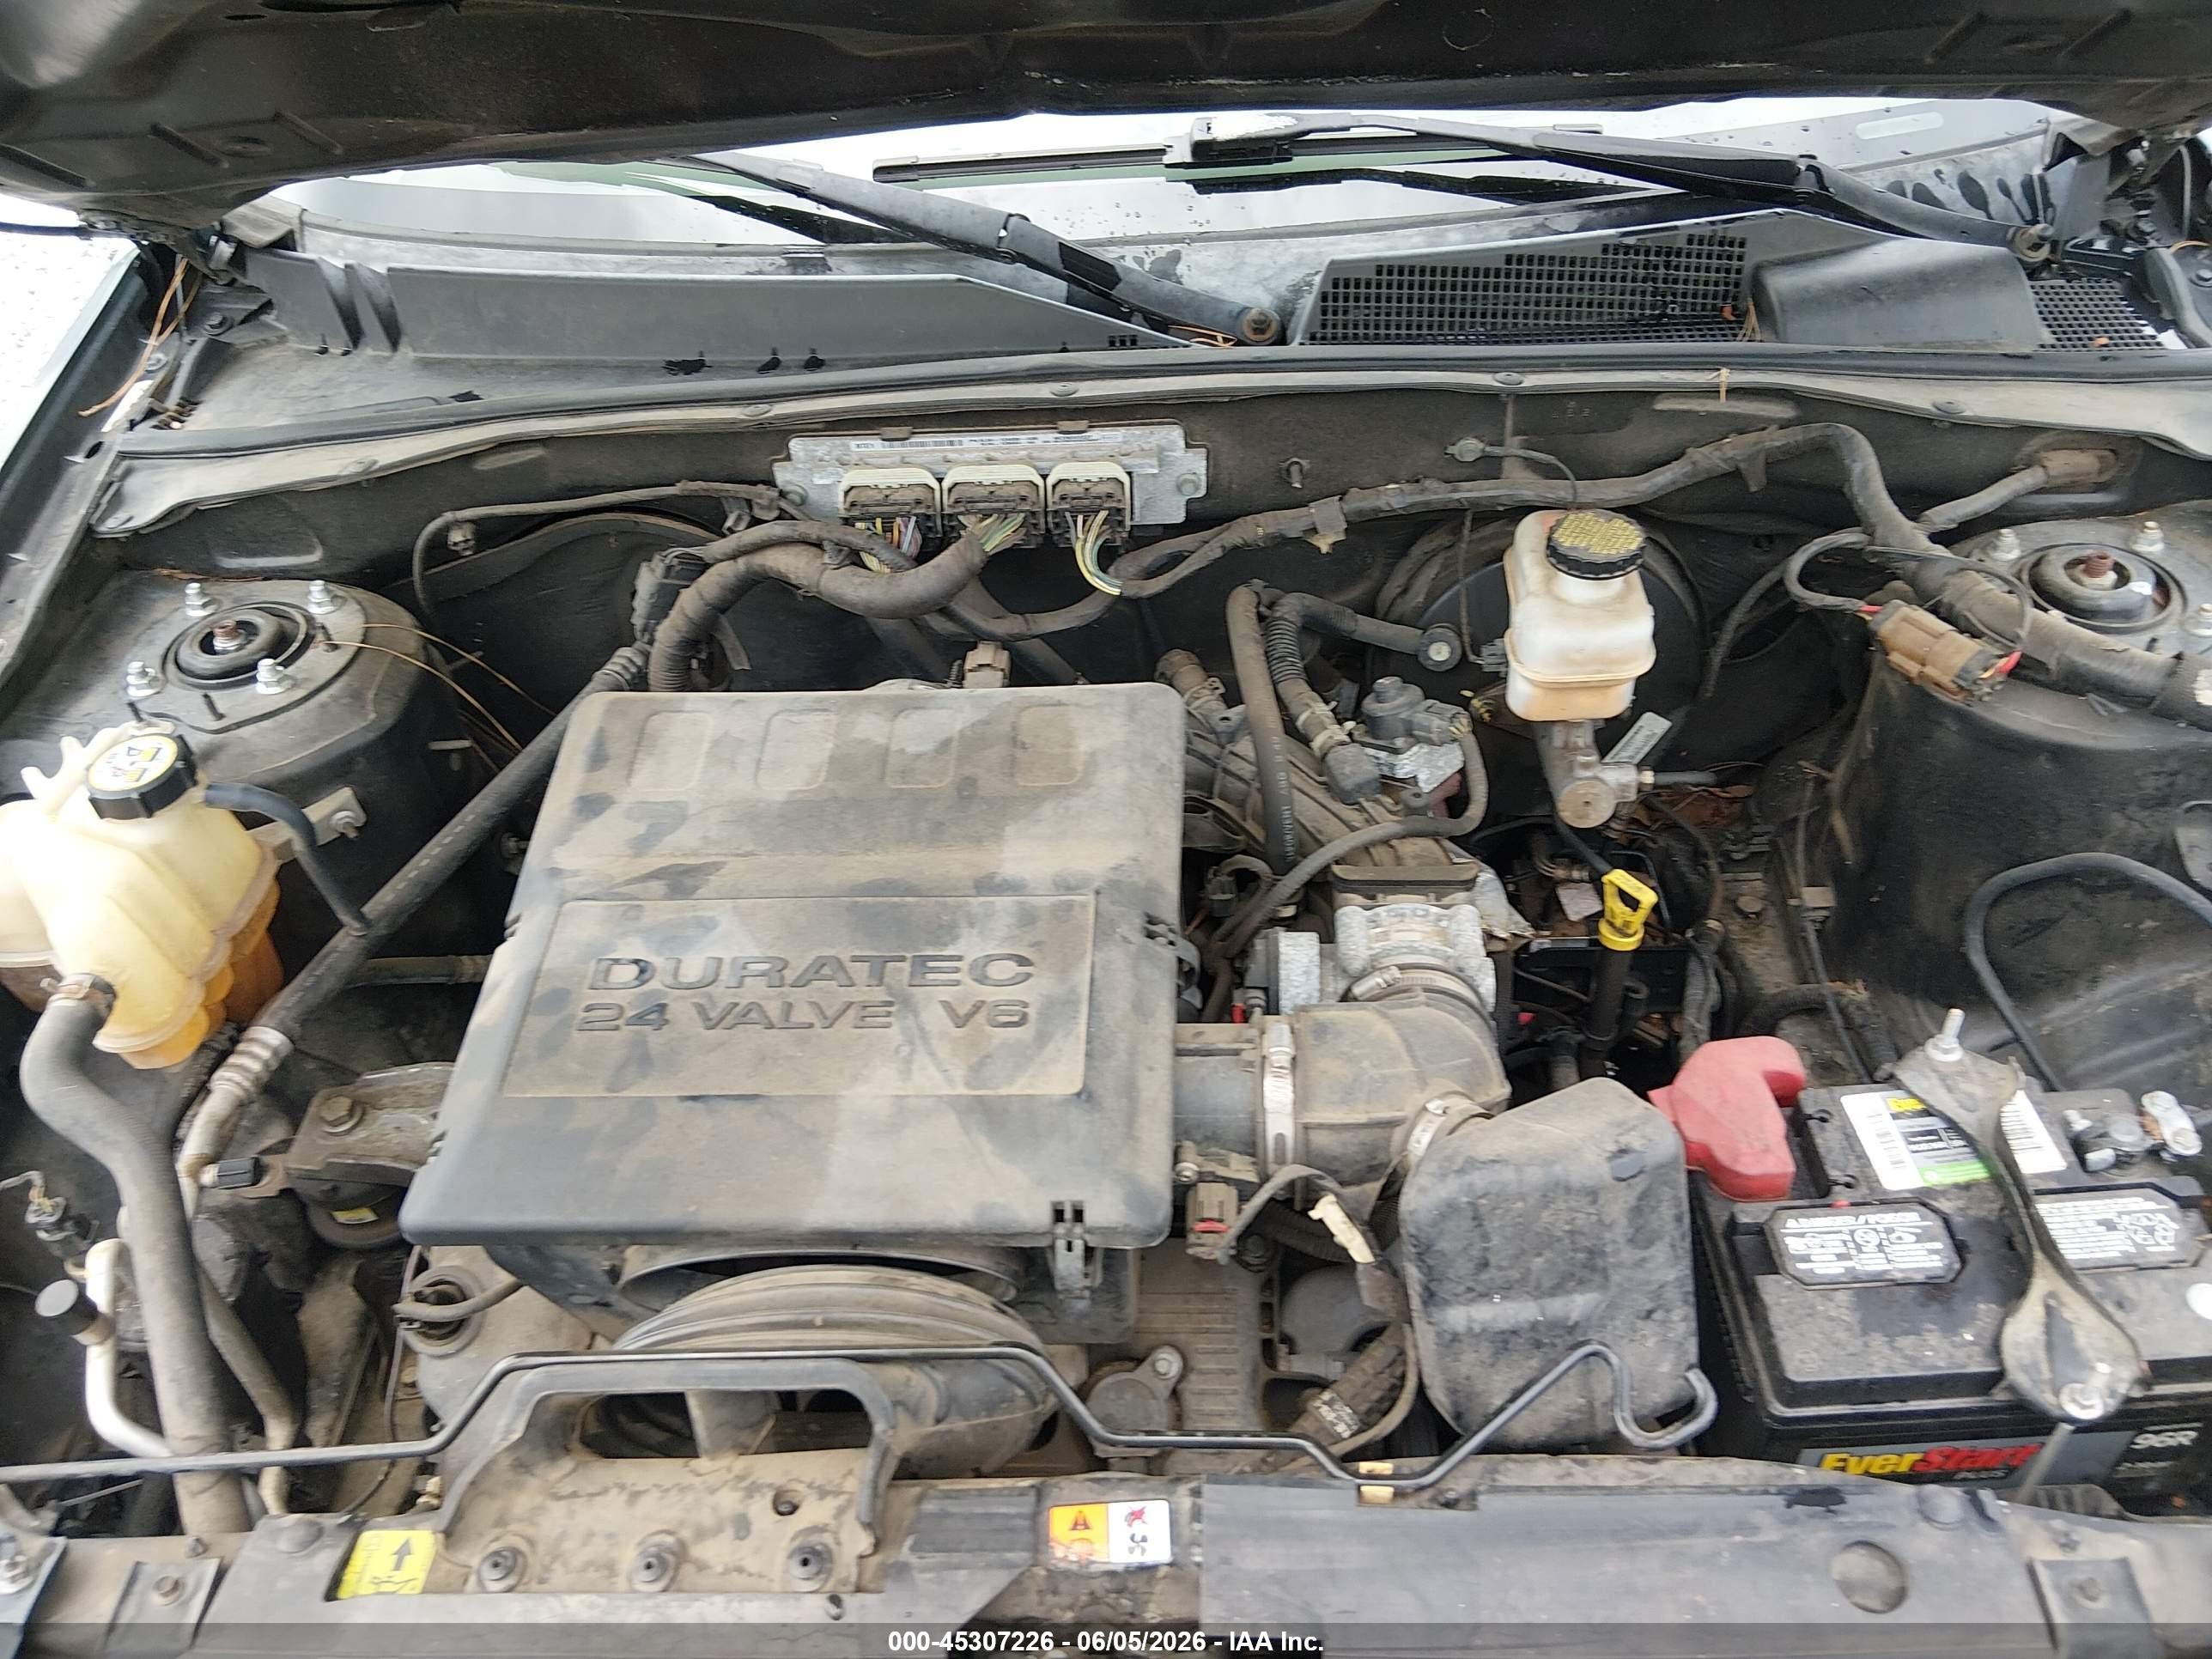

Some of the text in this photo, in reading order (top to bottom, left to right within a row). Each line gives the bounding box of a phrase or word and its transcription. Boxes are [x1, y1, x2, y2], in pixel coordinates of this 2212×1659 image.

[587, 952, 1035, 990] DURATEC
[576, 998, 1030, 1031] 24 VALVE V6
[2129, 1430, 2199, 1449] 96R
[1819, 1443, 2045, 1475] EverStart
